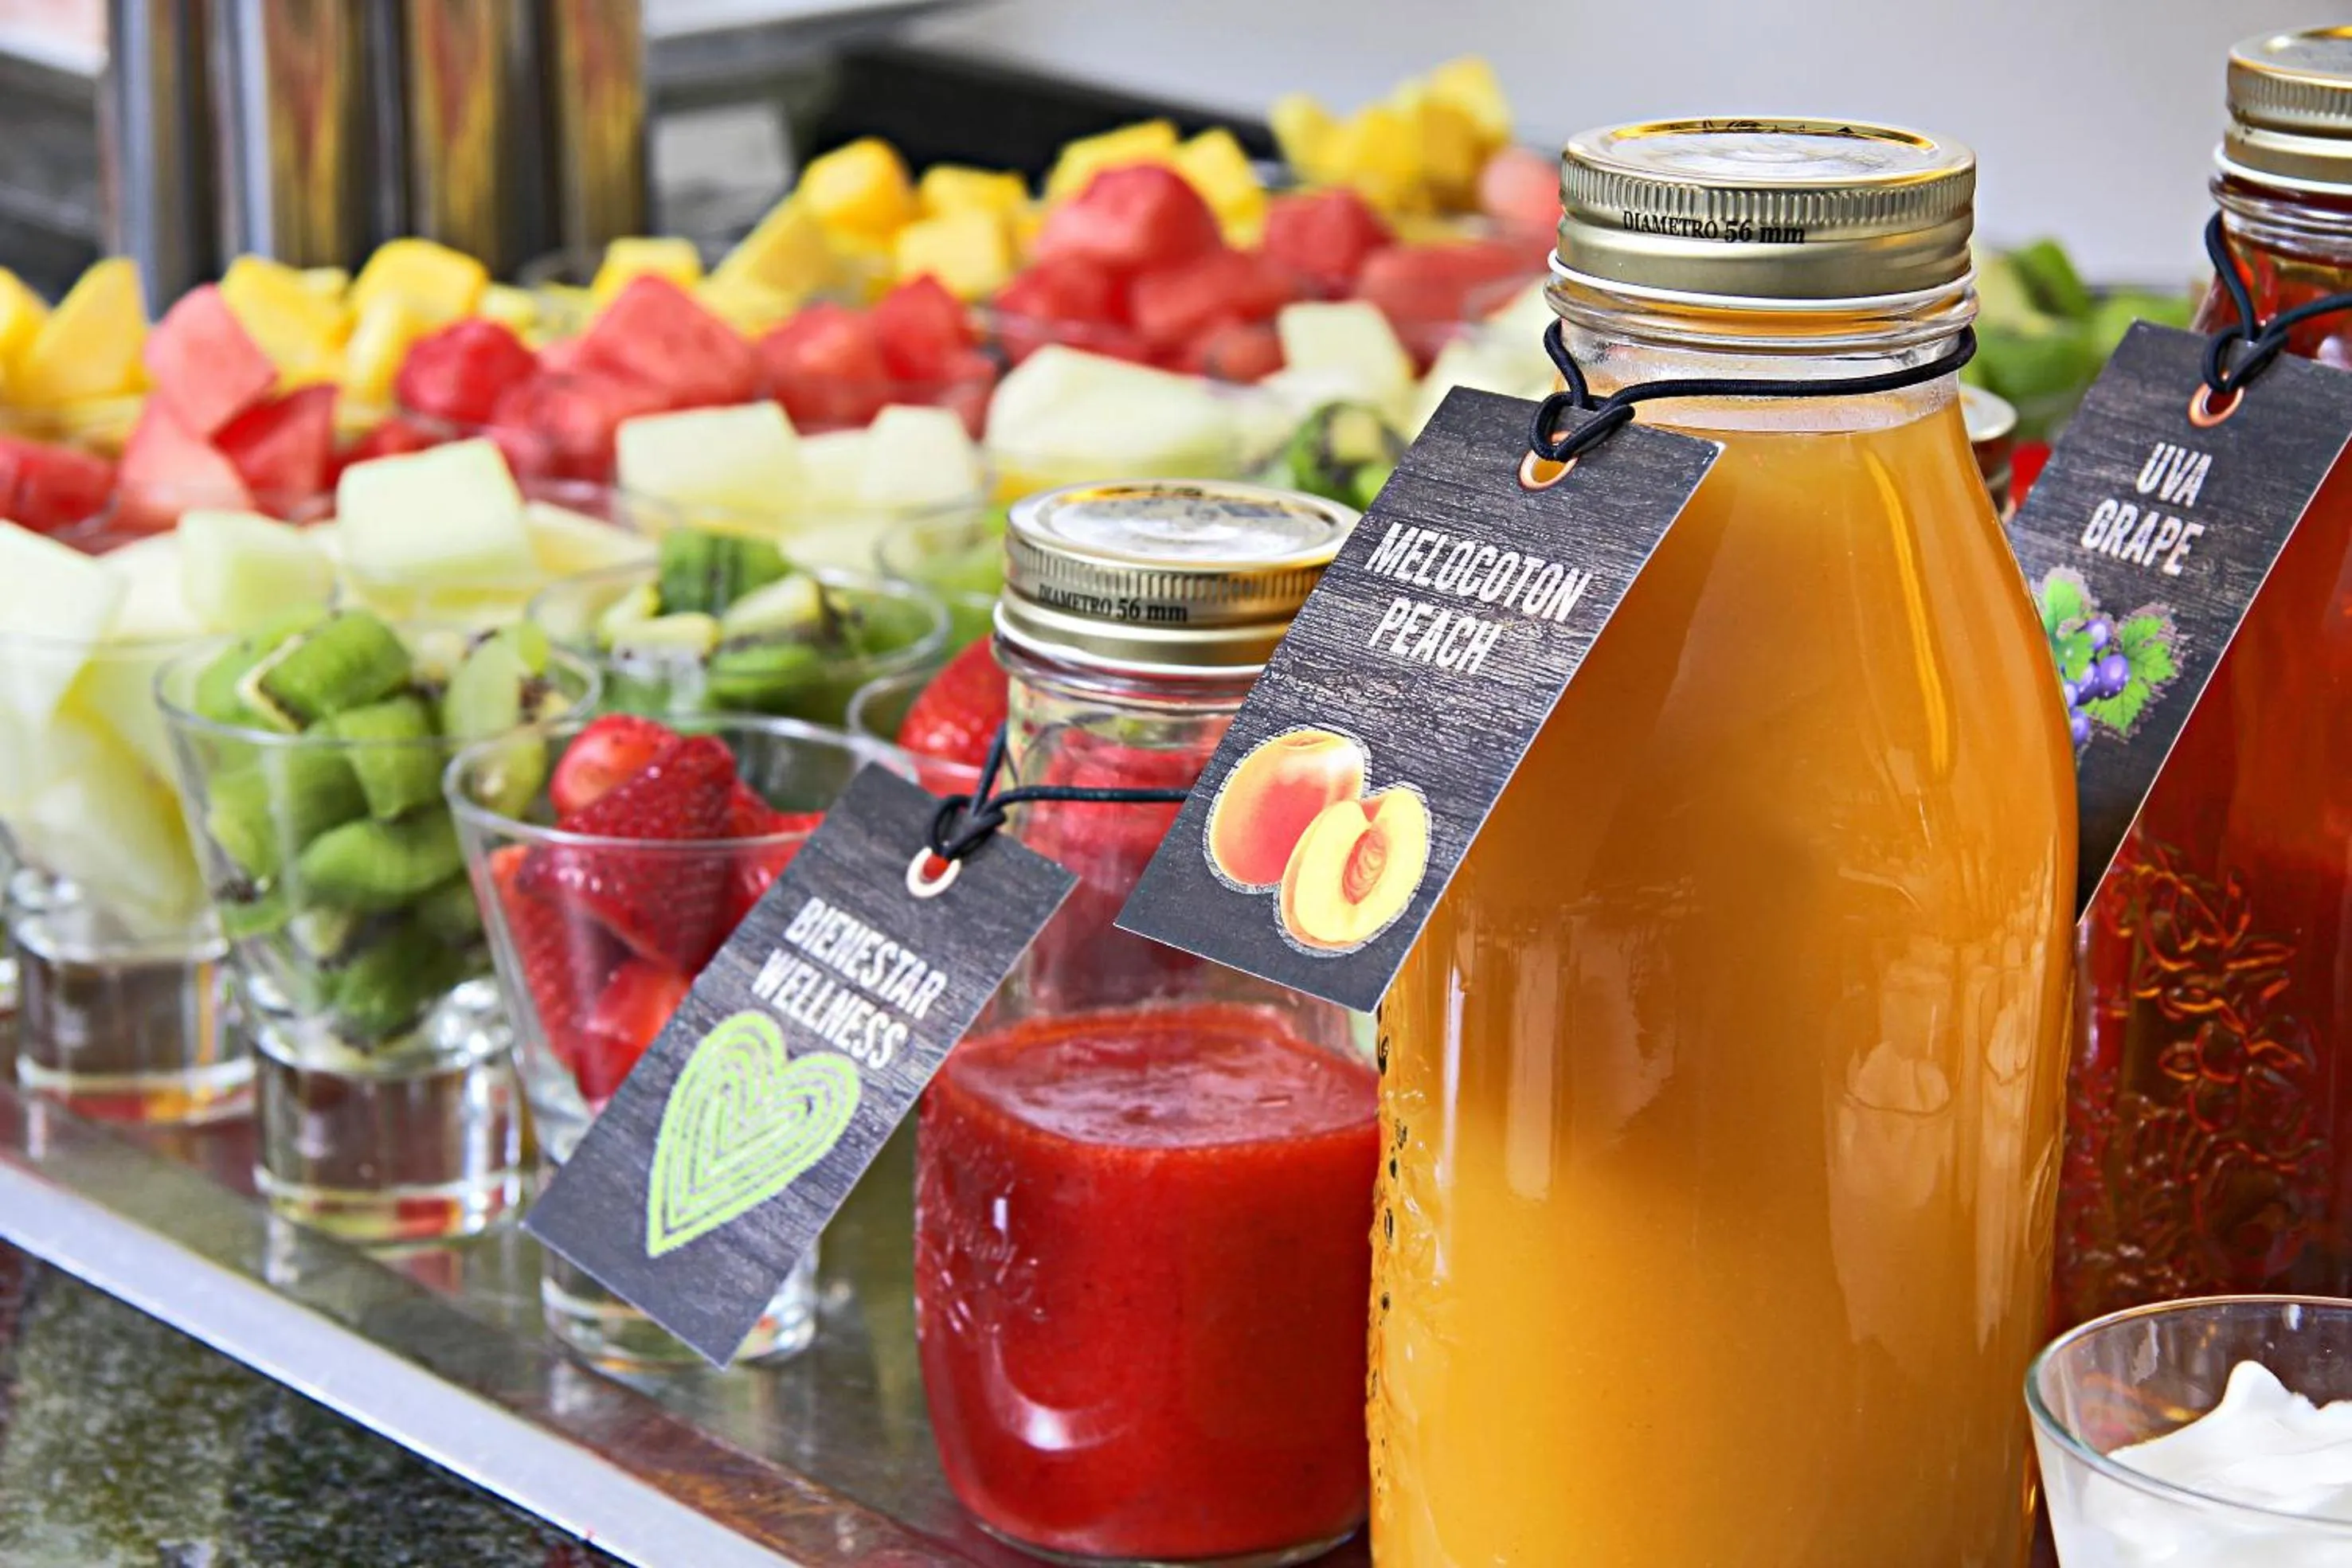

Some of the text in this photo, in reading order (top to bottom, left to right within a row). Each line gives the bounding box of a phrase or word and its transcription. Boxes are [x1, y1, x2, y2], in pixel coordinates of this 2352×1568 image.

[1622, 210, 1806, 244] DIAMETRO 56 mm
[2136, 441, 2213, 507] UVA
[1364, 522, 1591, 623] MELOCOTON
[2080, 498, 2205, 577] GRAPE
[1038, 583, 1188, 623] DIAMETRO 56 mm
[1368, 596, 1503, 675] PEACH
[784, 896, 947, 1019] BIENESTAR
[751, 947, 908, 1069] WELLNESS
